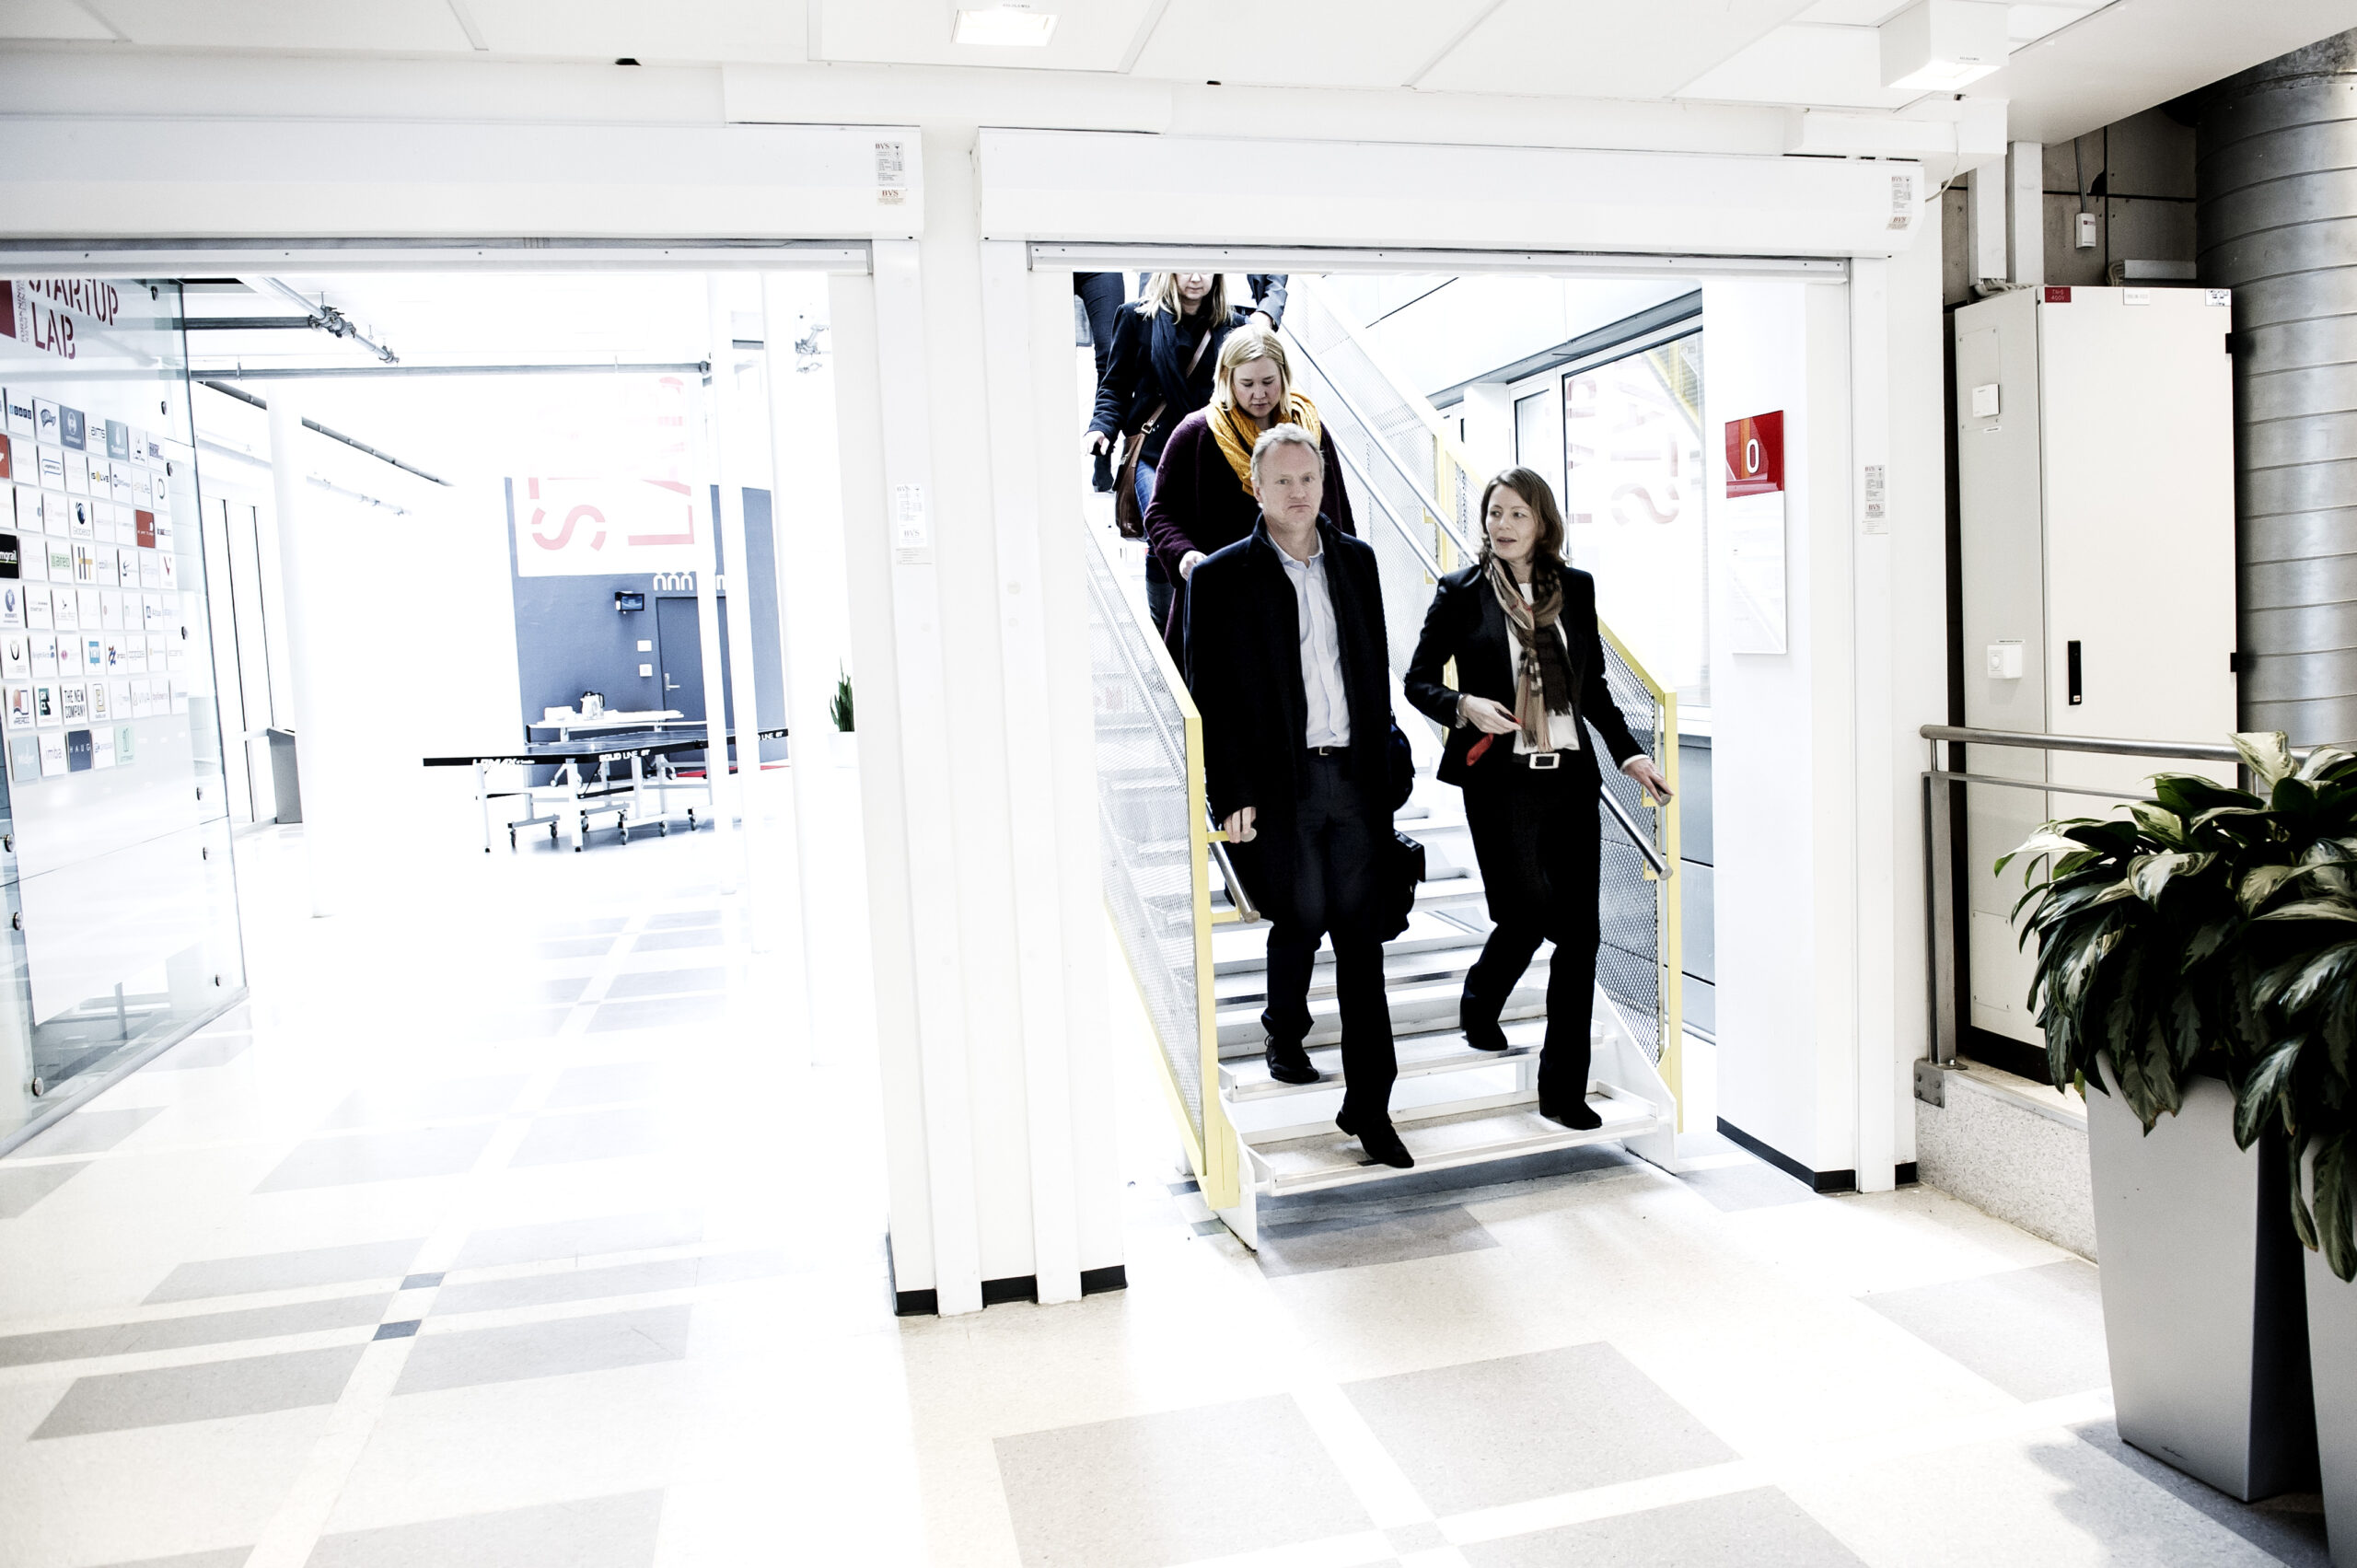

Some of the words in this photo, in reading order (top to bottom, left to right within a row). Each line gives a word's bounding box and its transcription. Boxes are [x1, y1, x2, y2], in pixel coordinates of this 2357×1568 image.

[29, 279, 119, 327] ARTUP
[31, 301, 76, 360] LAB
[1746, 438, 1760, 474] 0
